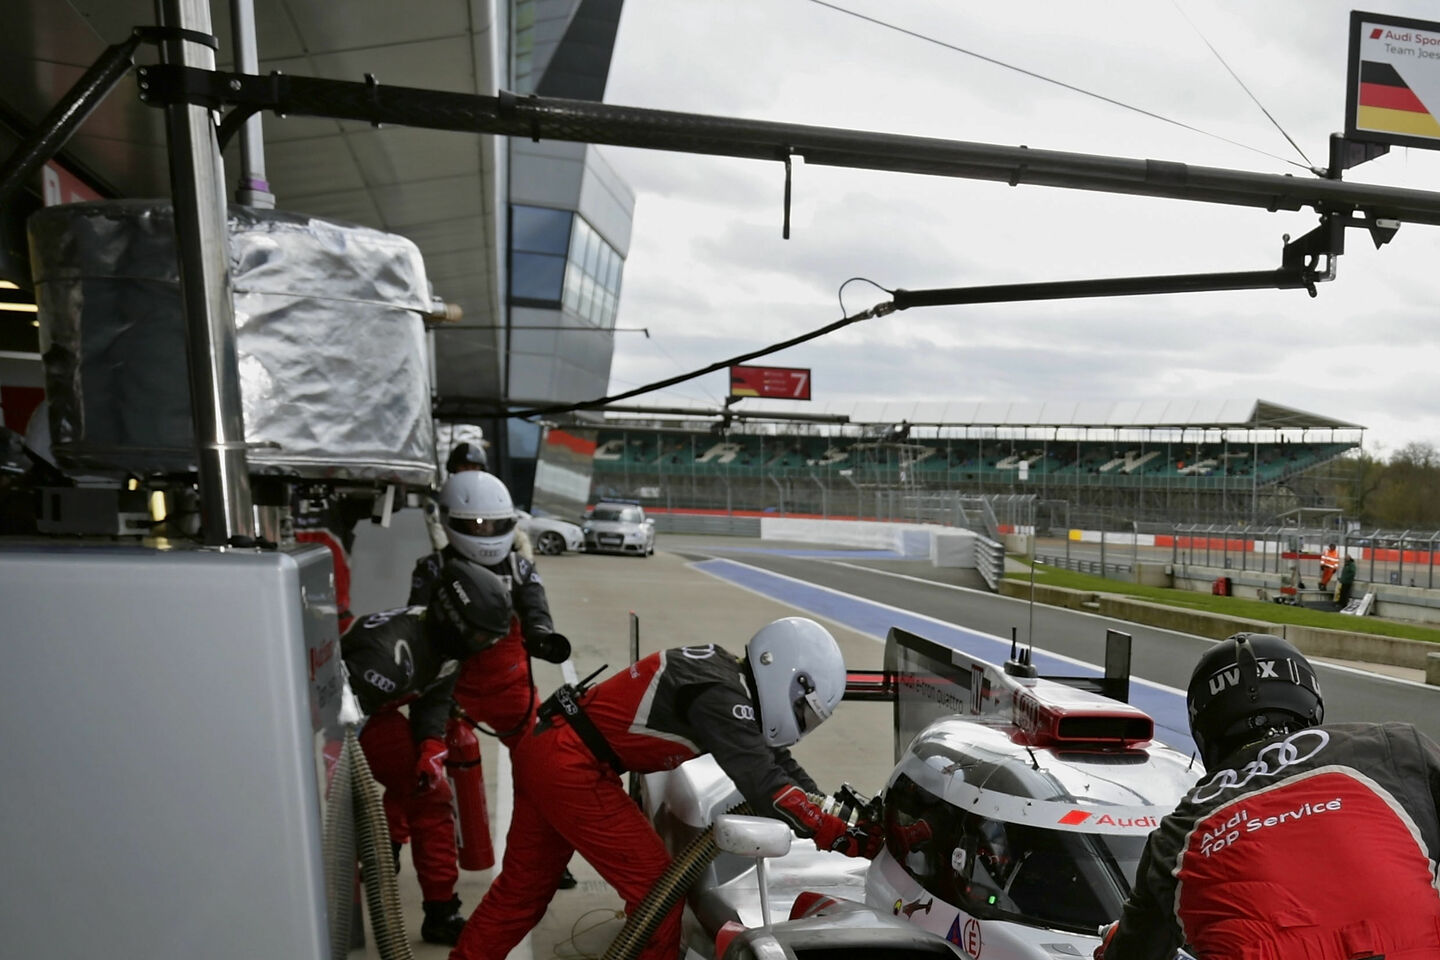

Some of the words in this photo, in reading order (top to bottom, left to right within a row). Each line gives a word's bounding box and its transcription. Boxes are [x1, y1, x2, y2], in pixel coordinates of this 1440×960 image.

[1385, 29, 1413, 43] Audi
[1385, 43, 1415, 57] Team
[790, 372, 809, 397] 7
[1208, 660, 1279, 696] uvx
[1096, 813, 1158, 828] Audi
[1200, 829, 1240, 858] Top
[1246, 798, 1342, 833] Service
[1200, 809, 1249, 849] Audi
